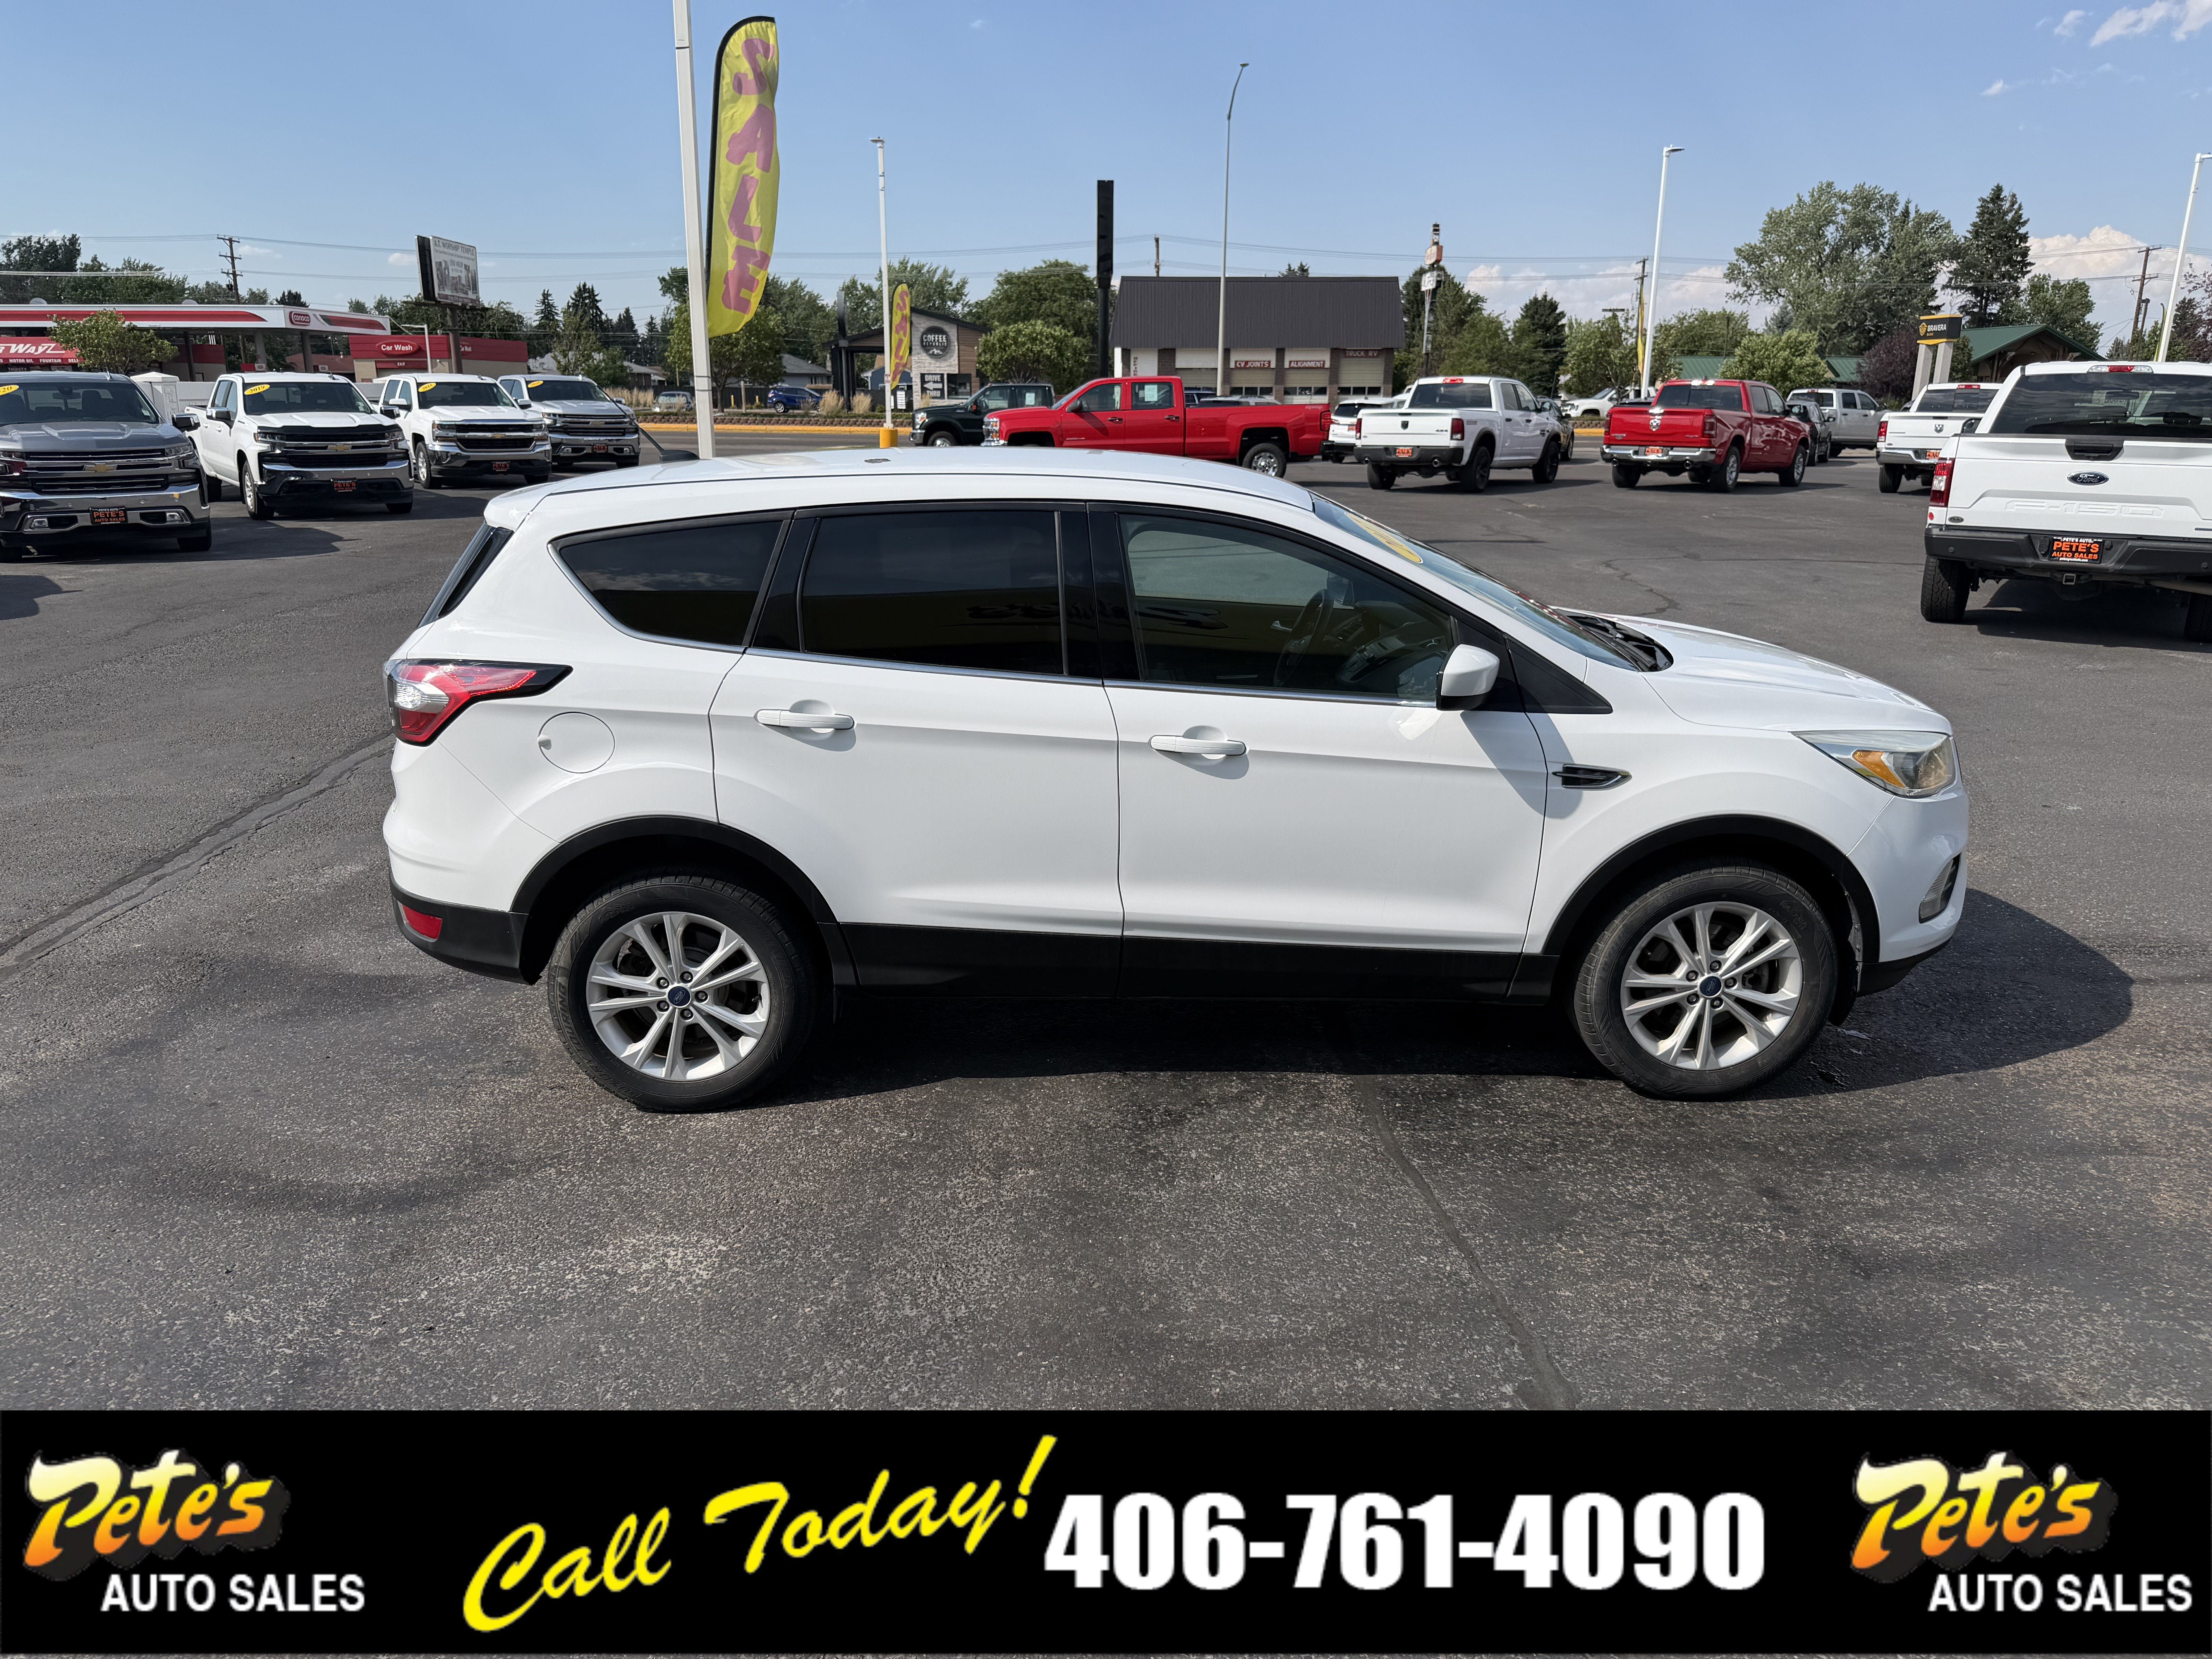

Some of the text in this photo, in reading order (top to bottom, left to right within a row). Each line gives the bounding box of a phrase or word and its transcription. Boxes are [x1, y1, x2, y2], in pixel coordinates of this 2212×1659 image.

[721, 38, 775, 315] SALE
[460, 246, 475, 256] TEMPLE
[250, 385, 265, 393] 2019
[2076, 474, 2100, 483] Ford
[2005, 500, 2164, 518] F-150
[2053, 541, 2099, 553] PETE'S
